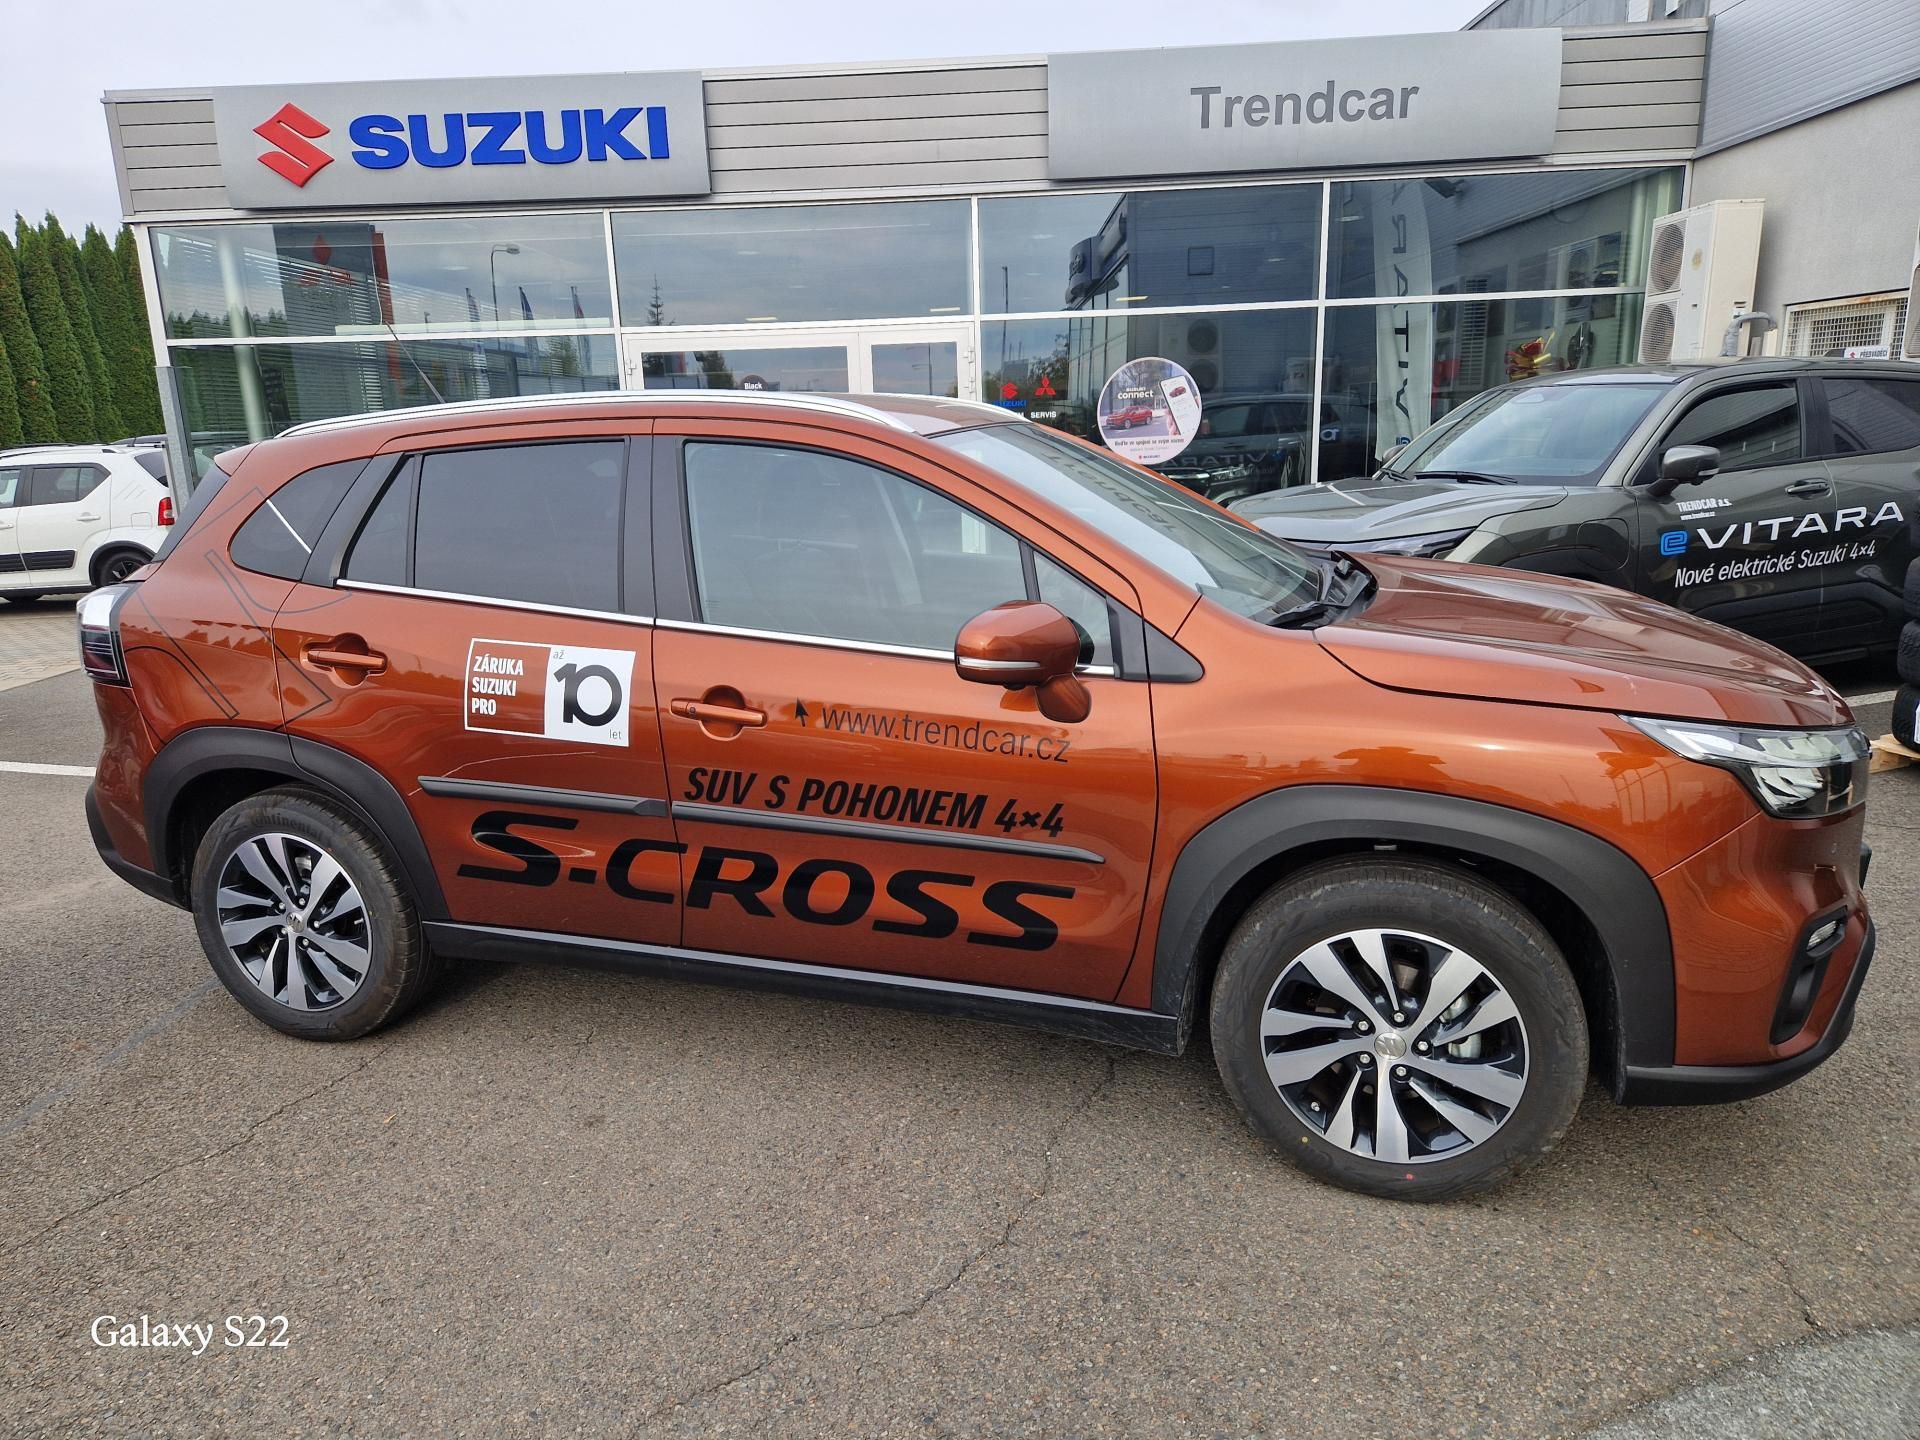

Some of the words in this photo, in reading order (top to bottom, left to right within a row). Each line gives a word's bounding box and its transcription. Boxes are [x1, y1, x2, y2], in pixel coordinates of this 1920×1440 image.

[1190, 80, 1420, 129] Trendcar
[349, 106, 670, 170] SUZUKI
[744, 381, 763, 390] Black
[1117, 389, 1154, 400] connect
[1030, 411, 1056, 419] SERVIS
[1676, 498, 1717, 512] TRENDCAR
[1674, 563, 1715, 588] Nové
[1718, 551, 1796, 580] elektrické
[1798, 544, 1847, 569] Suzuki
[473, 653, 524, 676] ZÁRUKA
[471, 677, 517, 697] SUZUKI
[553, 663, 623, 727] 10
[471, 697, 497, 716] PRO
[609, 729, 622, 740] let
[821, 706, 1072, 763] www.trendcar.cz
[684, 767, 758, 805] SUV
[764, 775, 790, 809] S
[797, 778, 987, 829] POHONEM
